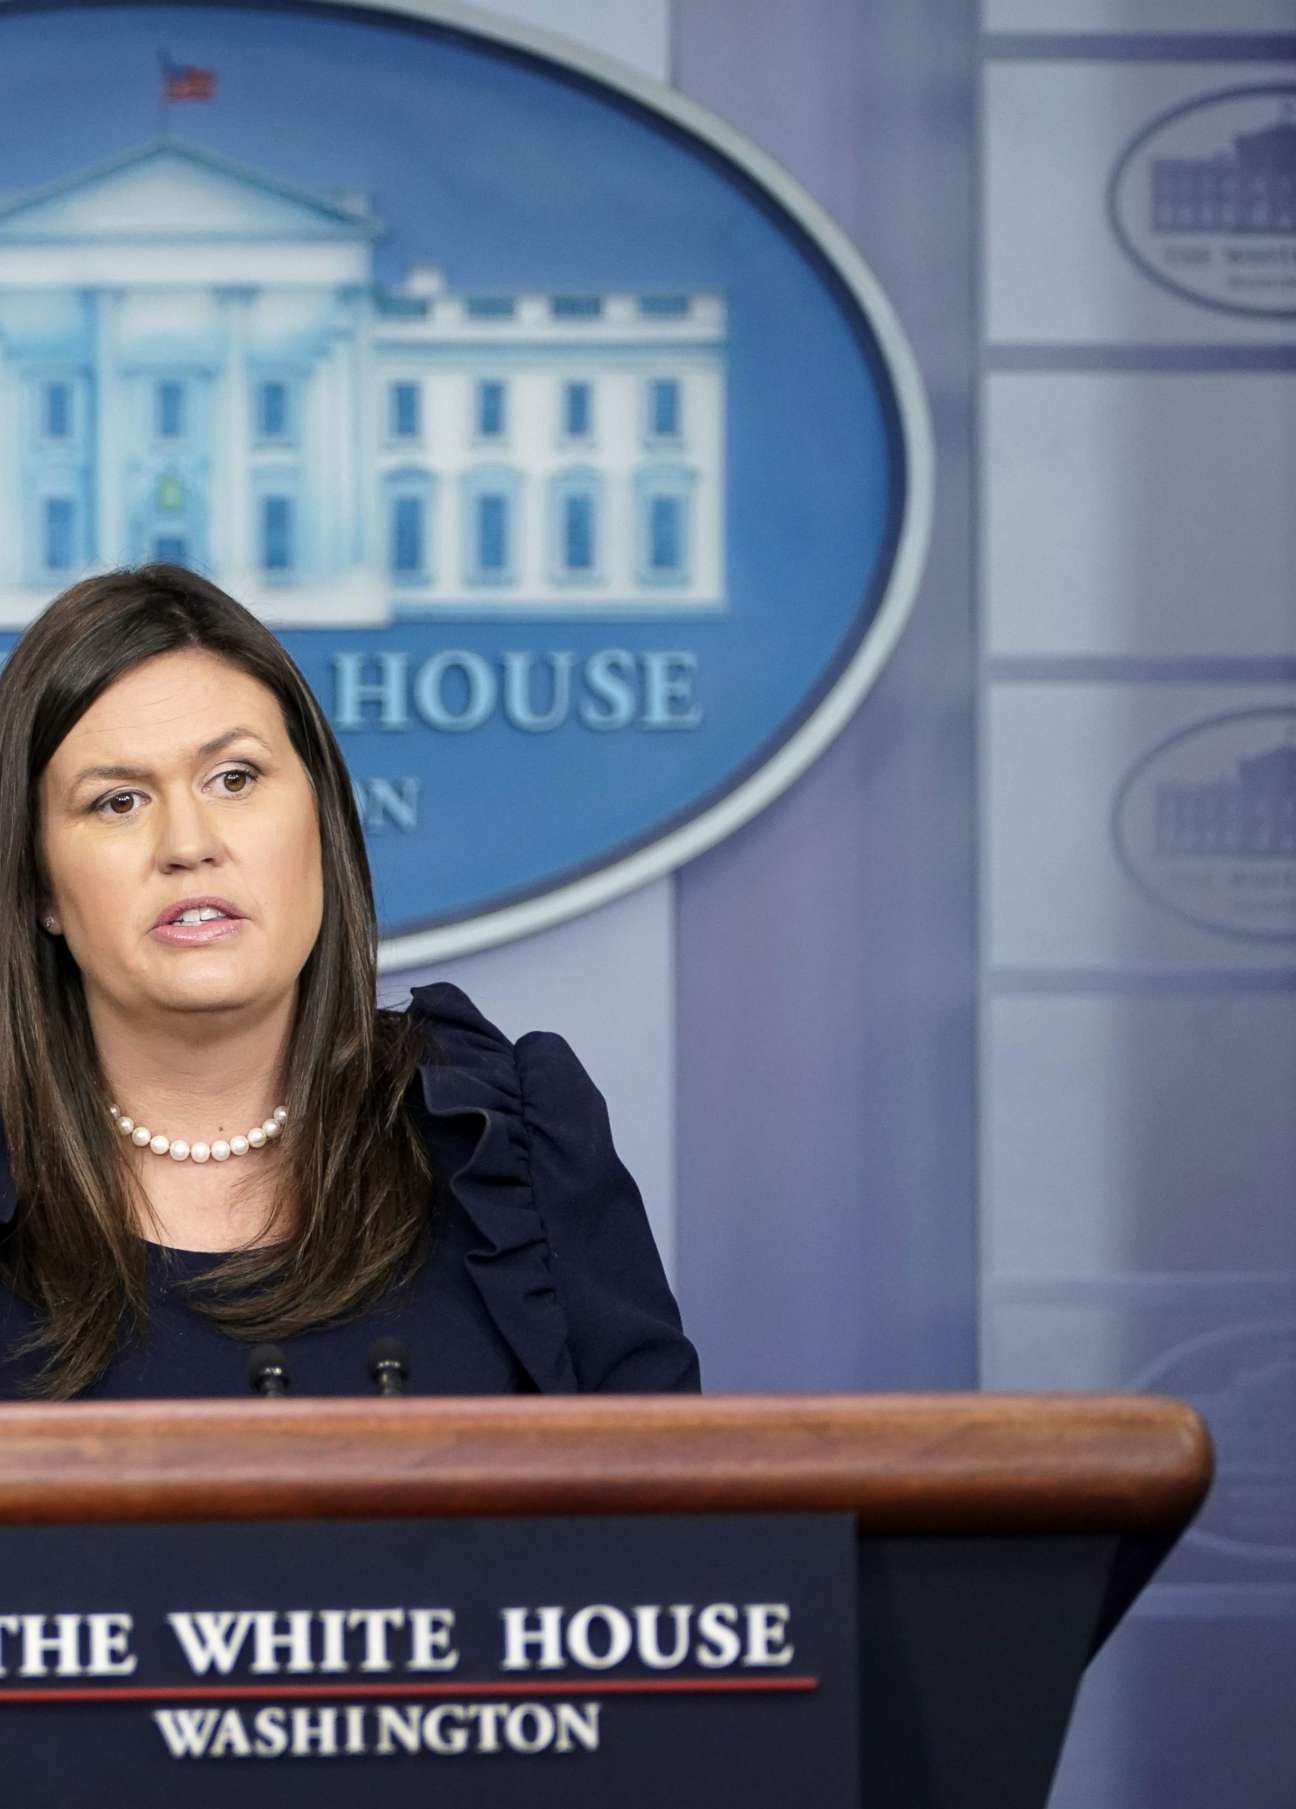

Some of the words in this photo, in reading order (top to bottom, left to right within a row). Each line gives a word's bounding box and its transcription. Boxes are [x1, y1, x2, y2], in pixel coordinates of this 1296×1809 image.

[334, 647, 703, 729] HOUSE
[167, 1608, 459, 1676] WHITE
[501, 1602, 794, 1671] HOUSE
[153, 1702, 600, 1758] WASHINGTON
